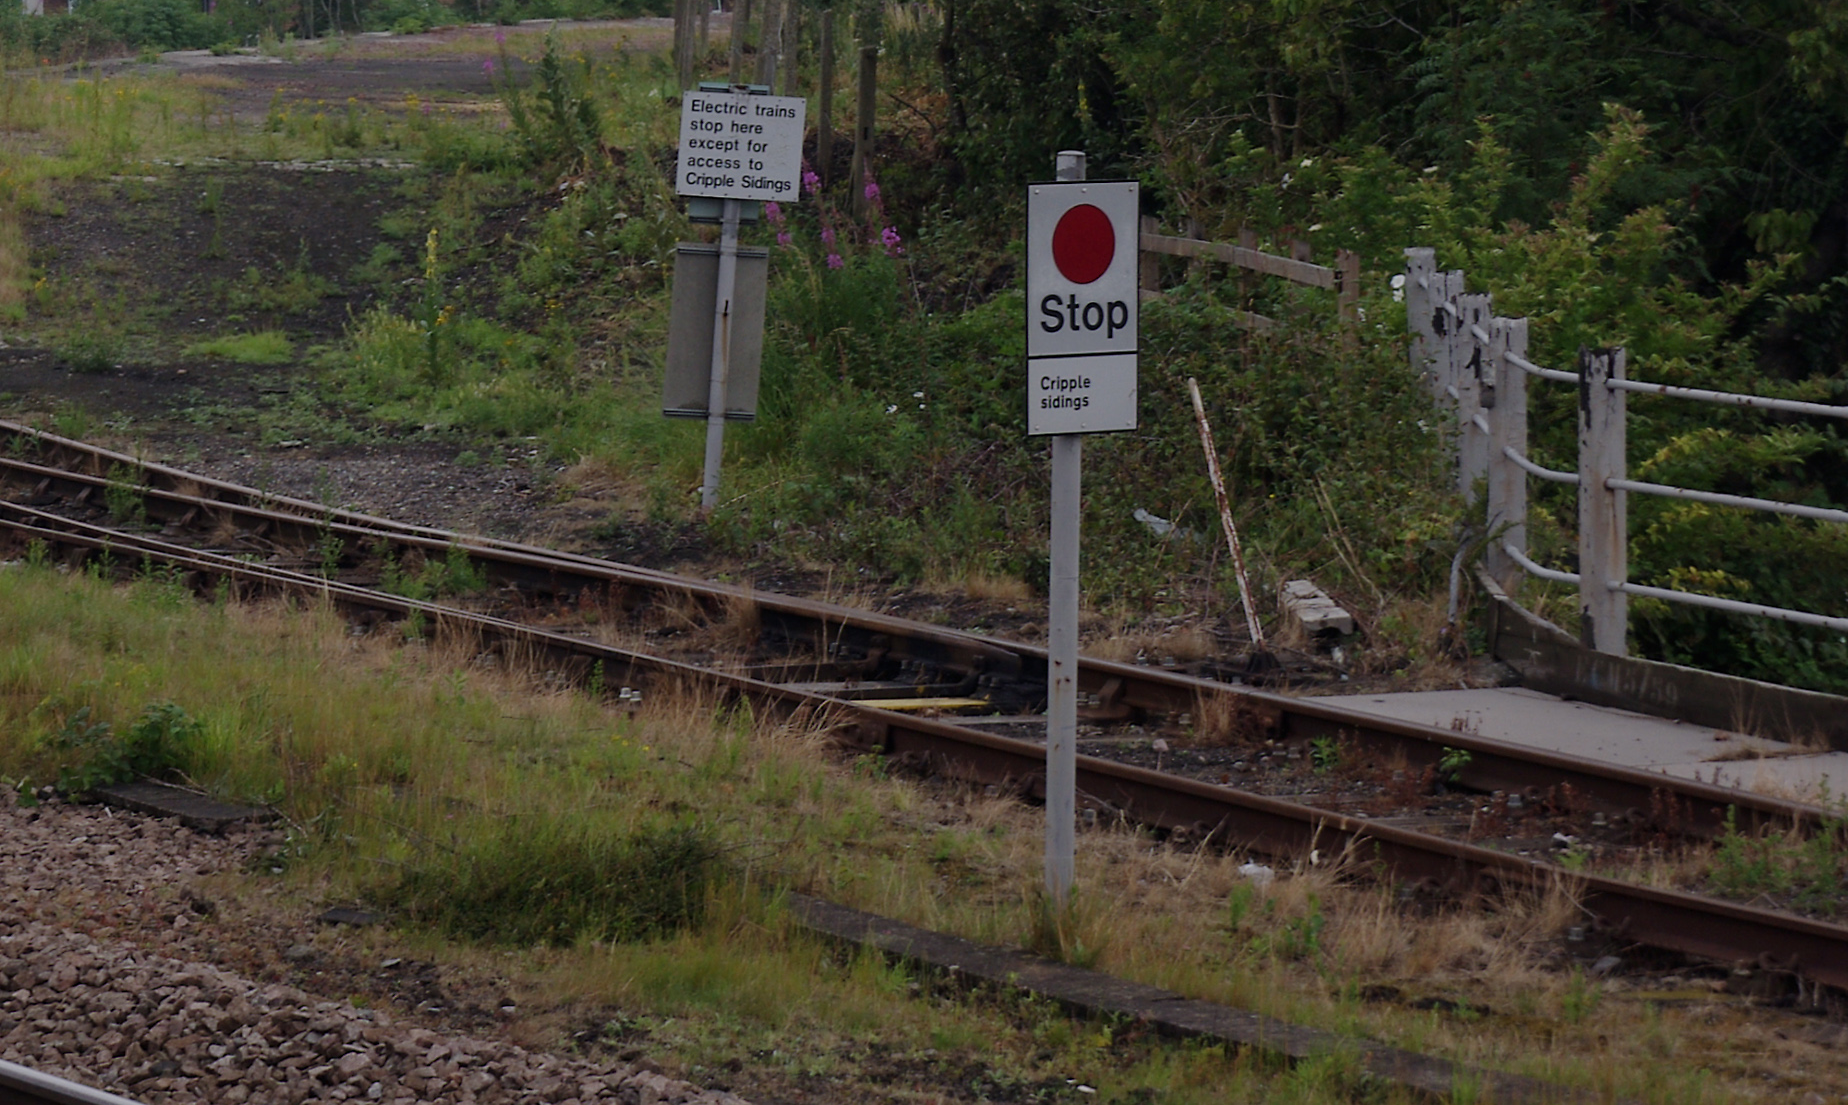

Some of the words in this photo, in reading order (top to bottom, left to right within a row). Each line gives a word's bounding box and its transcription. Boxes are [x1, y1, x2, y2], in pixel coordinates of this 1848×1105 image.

[691, 99, 748, 115] Electric
[755, 104, 796, 119] trains
[690, 119, 723, 133] stop
[730, 120, 763, 134] here
[688, 138, 739, 153] except
[747, 139, 768, 153] for
[687, 156, 741, 169] access
[748, 158, 763, 171] to
[686, 172, 734, 189] Cripple
[741, 175, 792, 193] Sidings
[1040, 294, 1129, 339] Stop
[1040, 375, 1091, 392] Cripple
[1040, 395, 1090, 411] sidings
